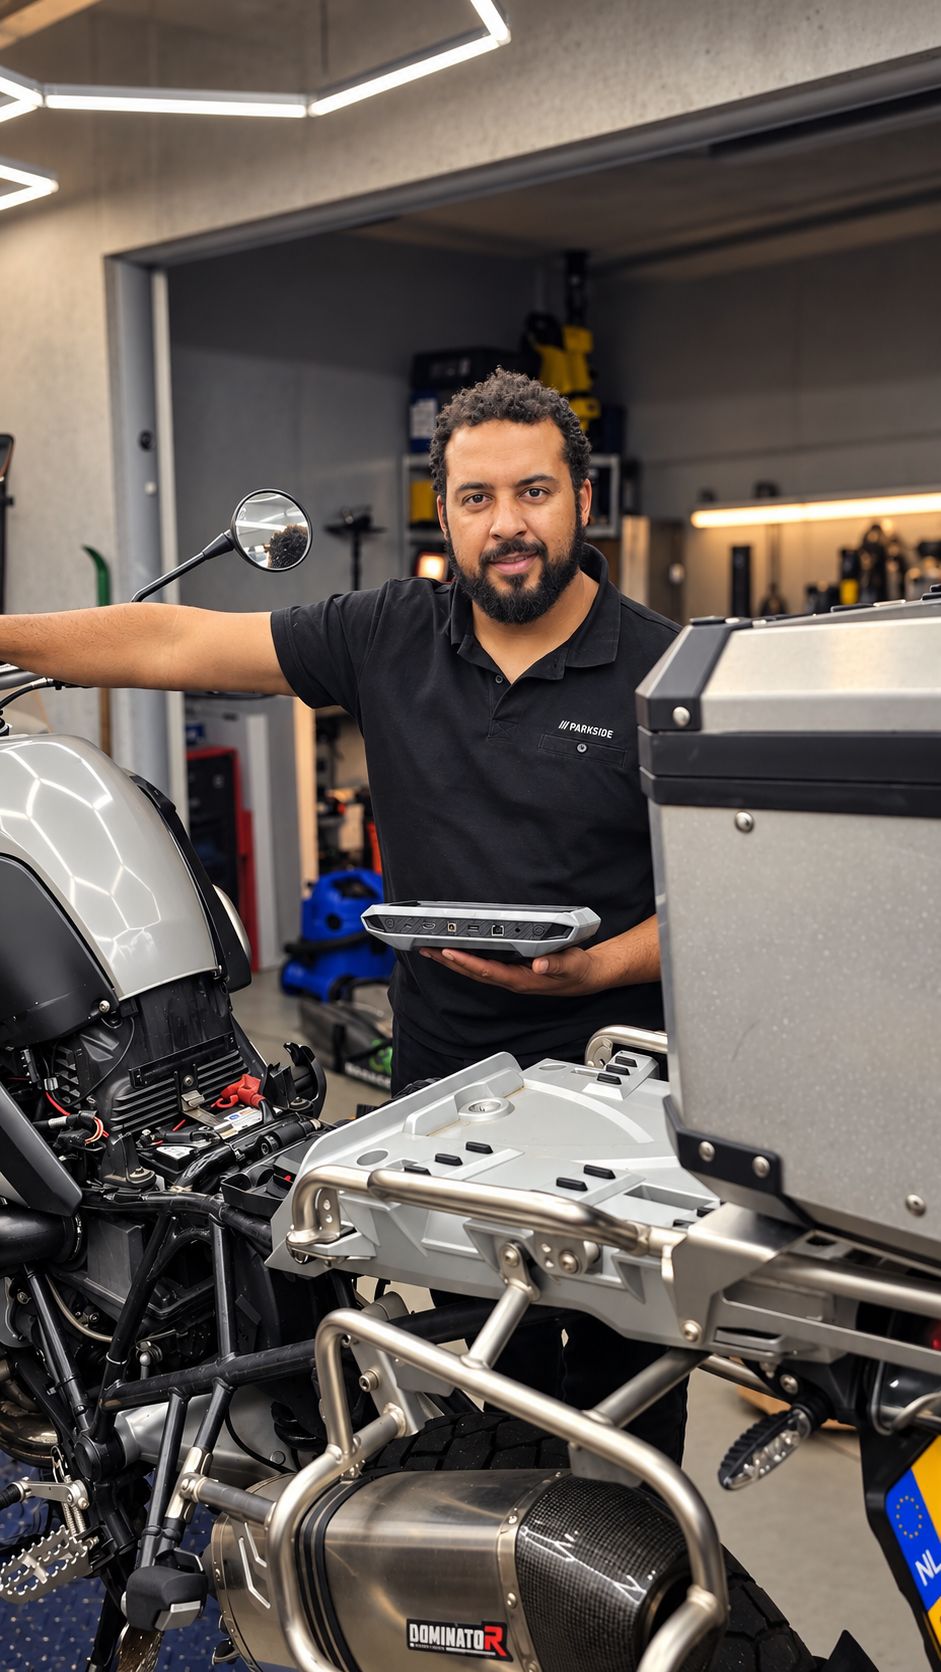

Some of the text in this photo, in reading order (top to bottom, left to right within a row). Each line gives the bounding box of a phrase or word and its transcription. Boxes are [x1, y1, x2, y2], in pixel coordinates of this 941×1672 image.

[569, 722, 614, 739] PARKSIDE
[915, 1549, 941, 1587] NL
[409, 1623, 507, 1657] DOMINATOR
